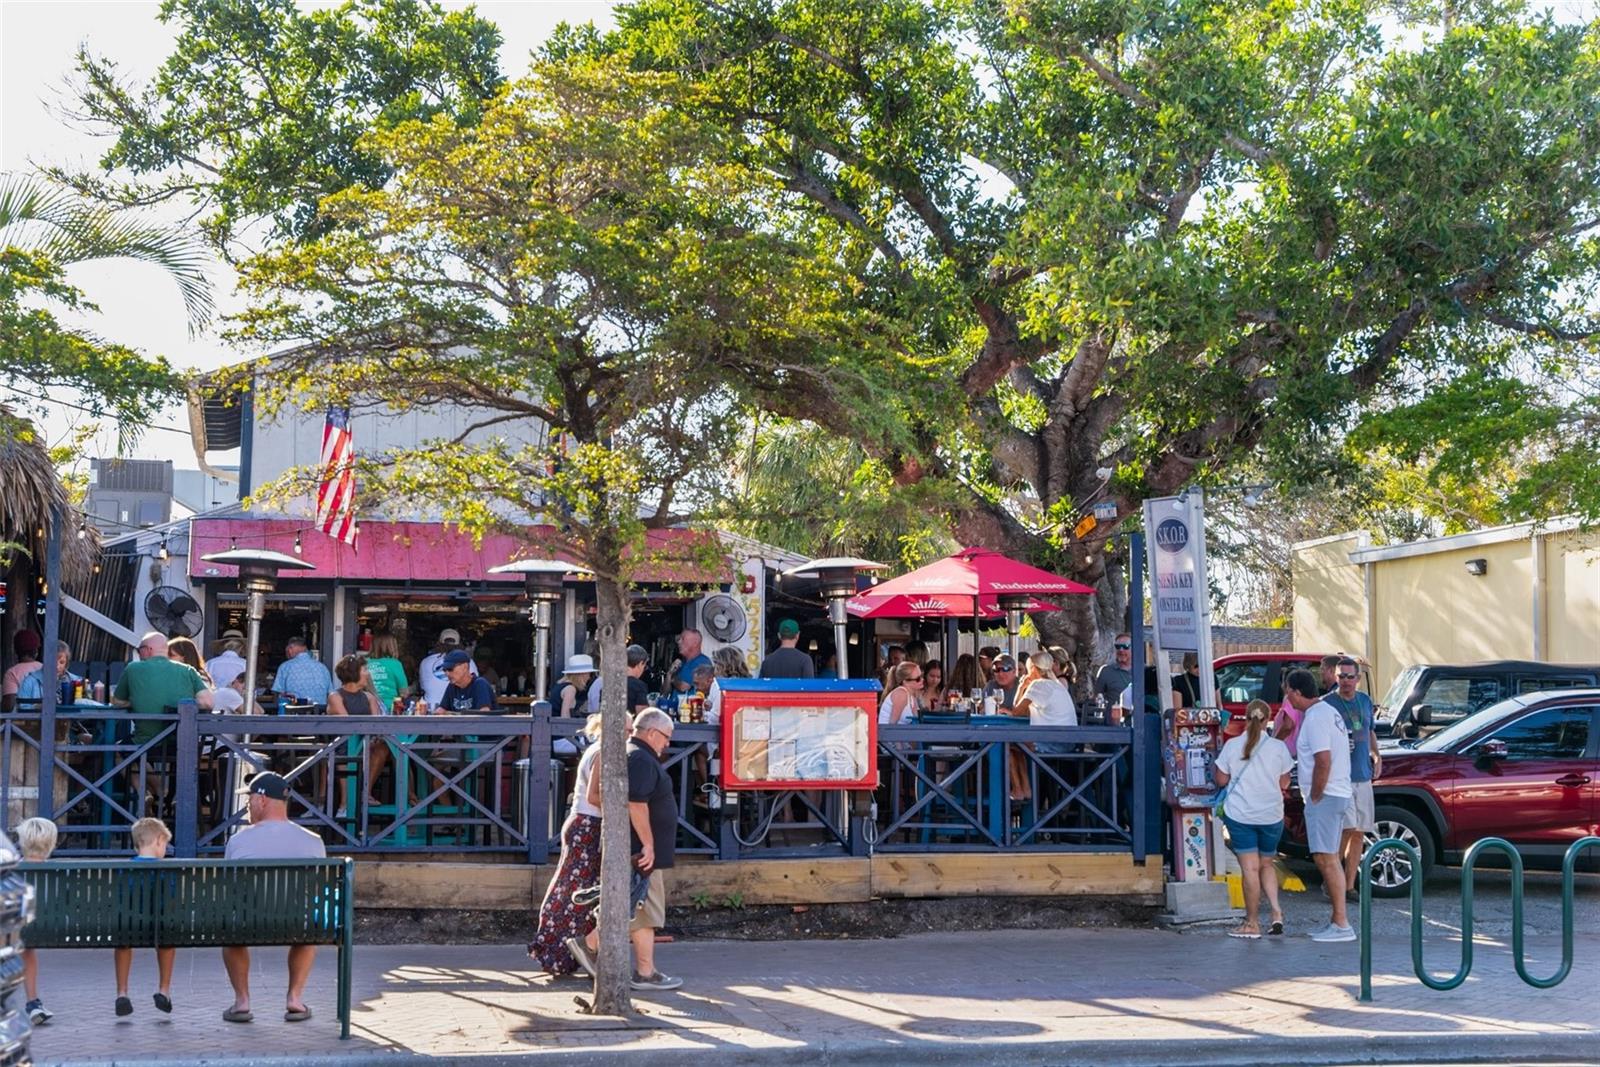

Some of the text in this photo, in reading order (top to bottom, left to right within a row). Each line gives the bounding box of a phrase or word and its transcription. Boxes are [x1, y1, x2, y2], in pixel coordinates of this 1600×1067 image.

[990, 582, 1069, 590] Budweiser
[1179, 572, 1193, 588] KEY
[1181, 597, 1195, 612] BAR
